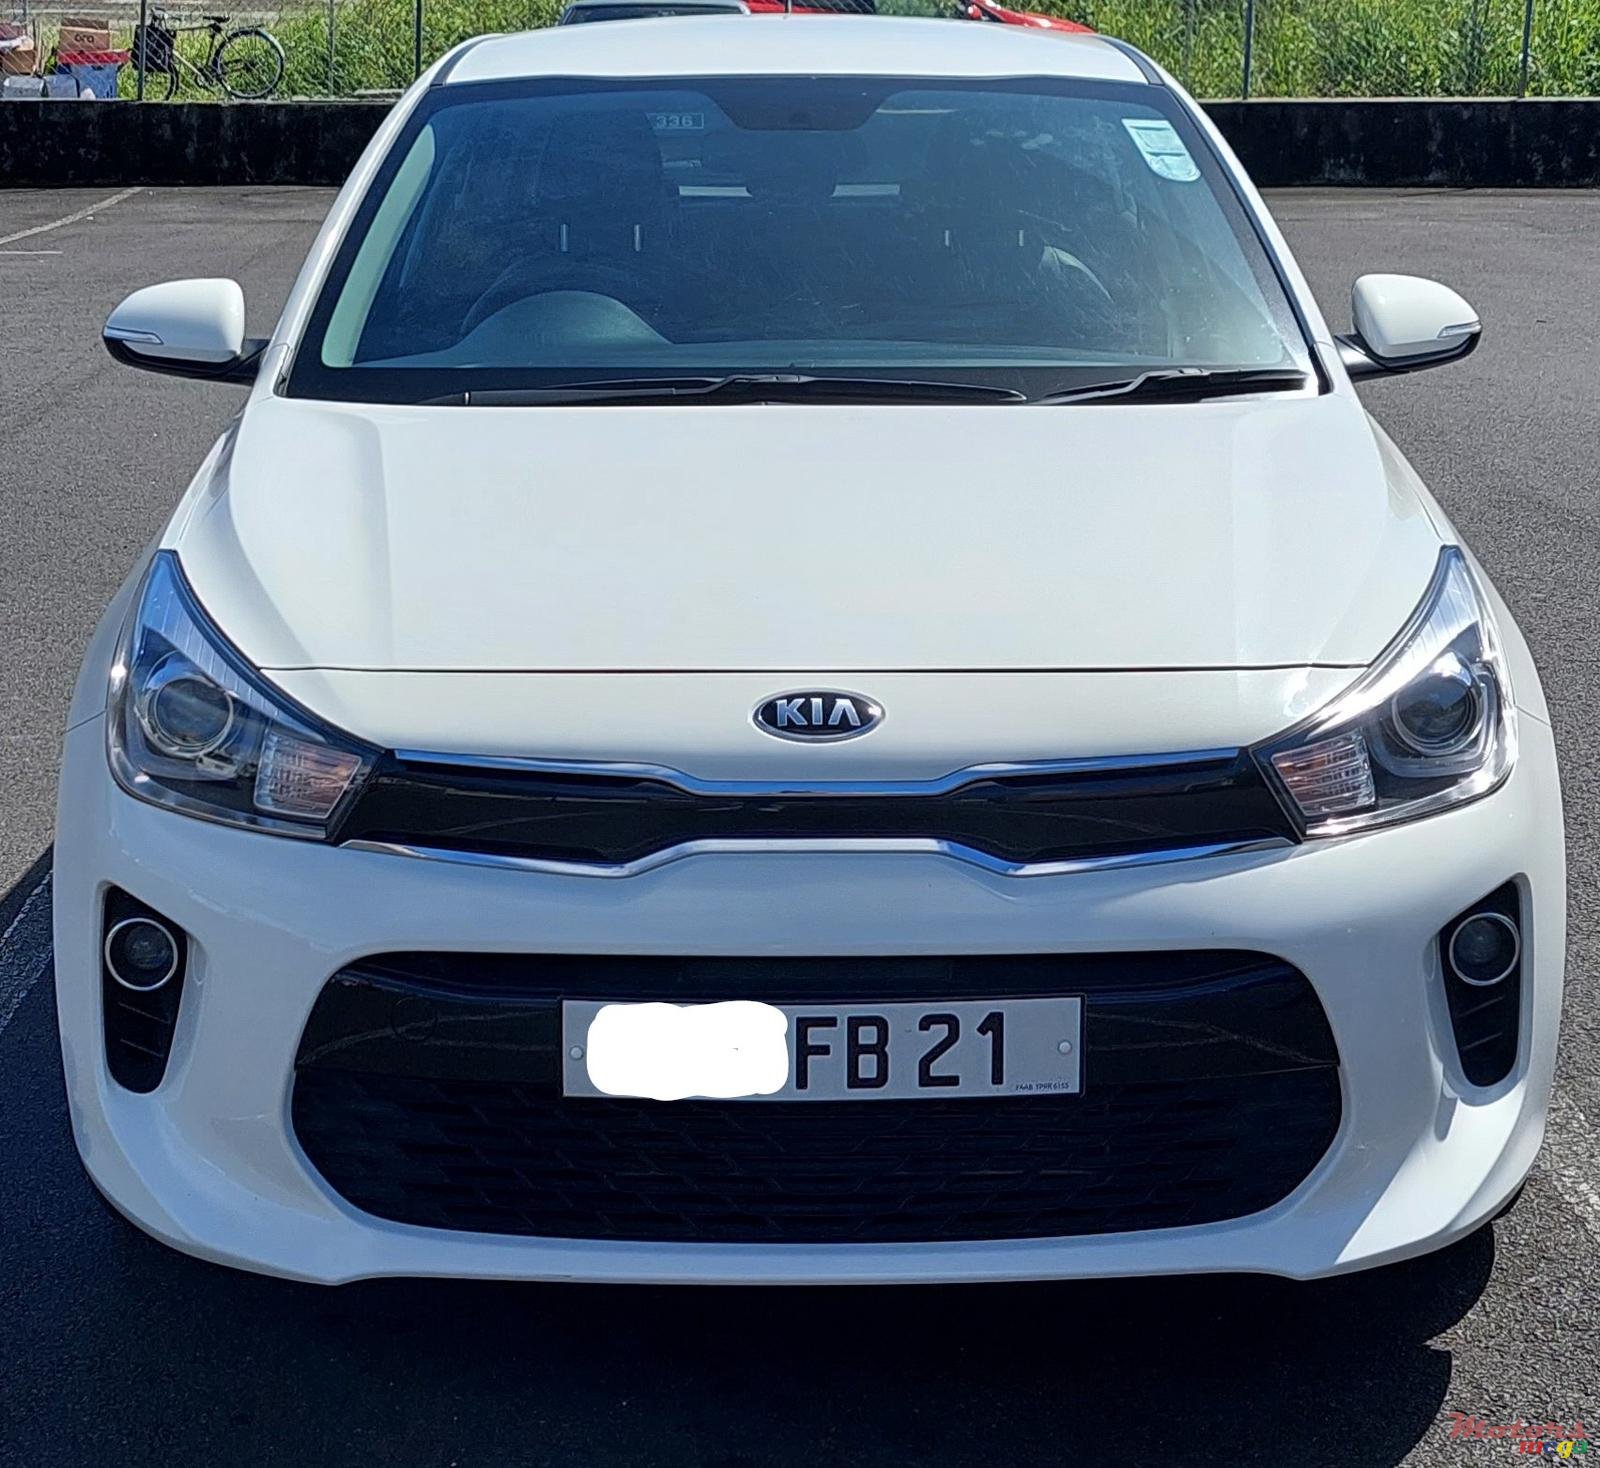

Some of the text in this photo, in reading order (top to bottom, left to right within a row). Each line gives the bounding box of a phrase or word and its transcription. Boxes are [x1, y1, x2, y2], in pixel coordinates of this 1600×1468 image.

[656, 115, 693, 128] 336
[776, 698, 861, 727] KIA
[795, 1011, 1004, 1090] FB 21
